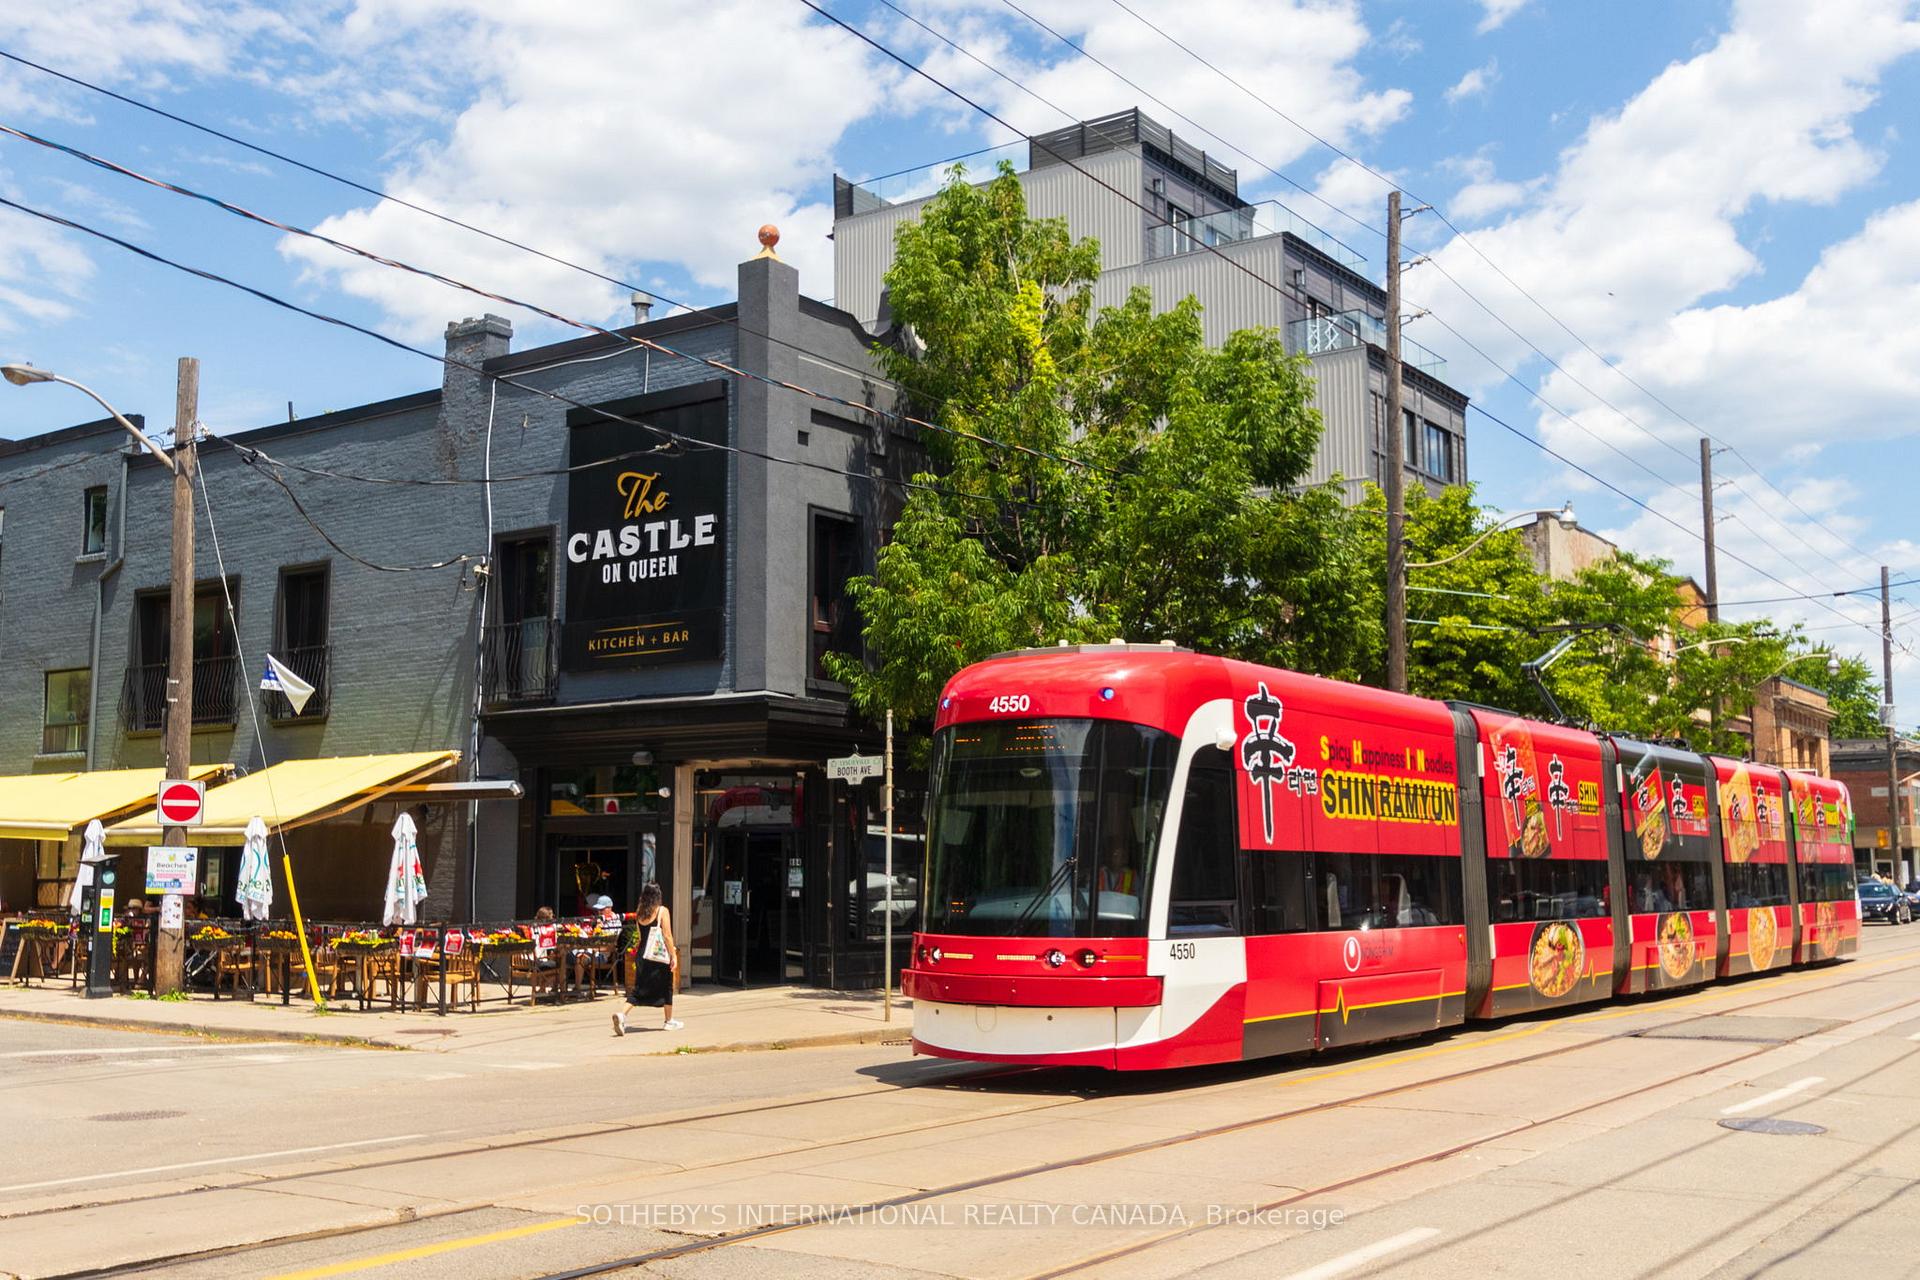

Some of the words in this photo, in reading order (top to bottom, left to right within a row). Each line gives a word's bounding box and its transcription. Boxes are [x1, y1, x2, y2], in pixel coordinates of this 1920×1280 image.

[617, 471, 669, 520] The
[567, 513, 719, 564] CASTLE
[602, 562, 622, 584] ON
[629, 554, 678, 583] QUEEN
[588, 635, 645, 651] KITCHEN
[663, 630, 689, 644] BAR
[989, 694, 1030, 713] 4550
[1320, 735, 1351, 769] Spicy
[1353, 740, 1405, 768] Happiness
[1406, 747, 1416, 771] In
[1417, 748, 1454, 774] Noodles
[837, 766, 858, 777] BOOTH
[860, 765, 872, 775] AVE
[1321, 768, 1377, 820] SHIN
[1378, 775, 1457, 825] RAMYUN
[1579, 782, 1598, 802] SHIN
[1170, 942, 1196, 961] 4550
